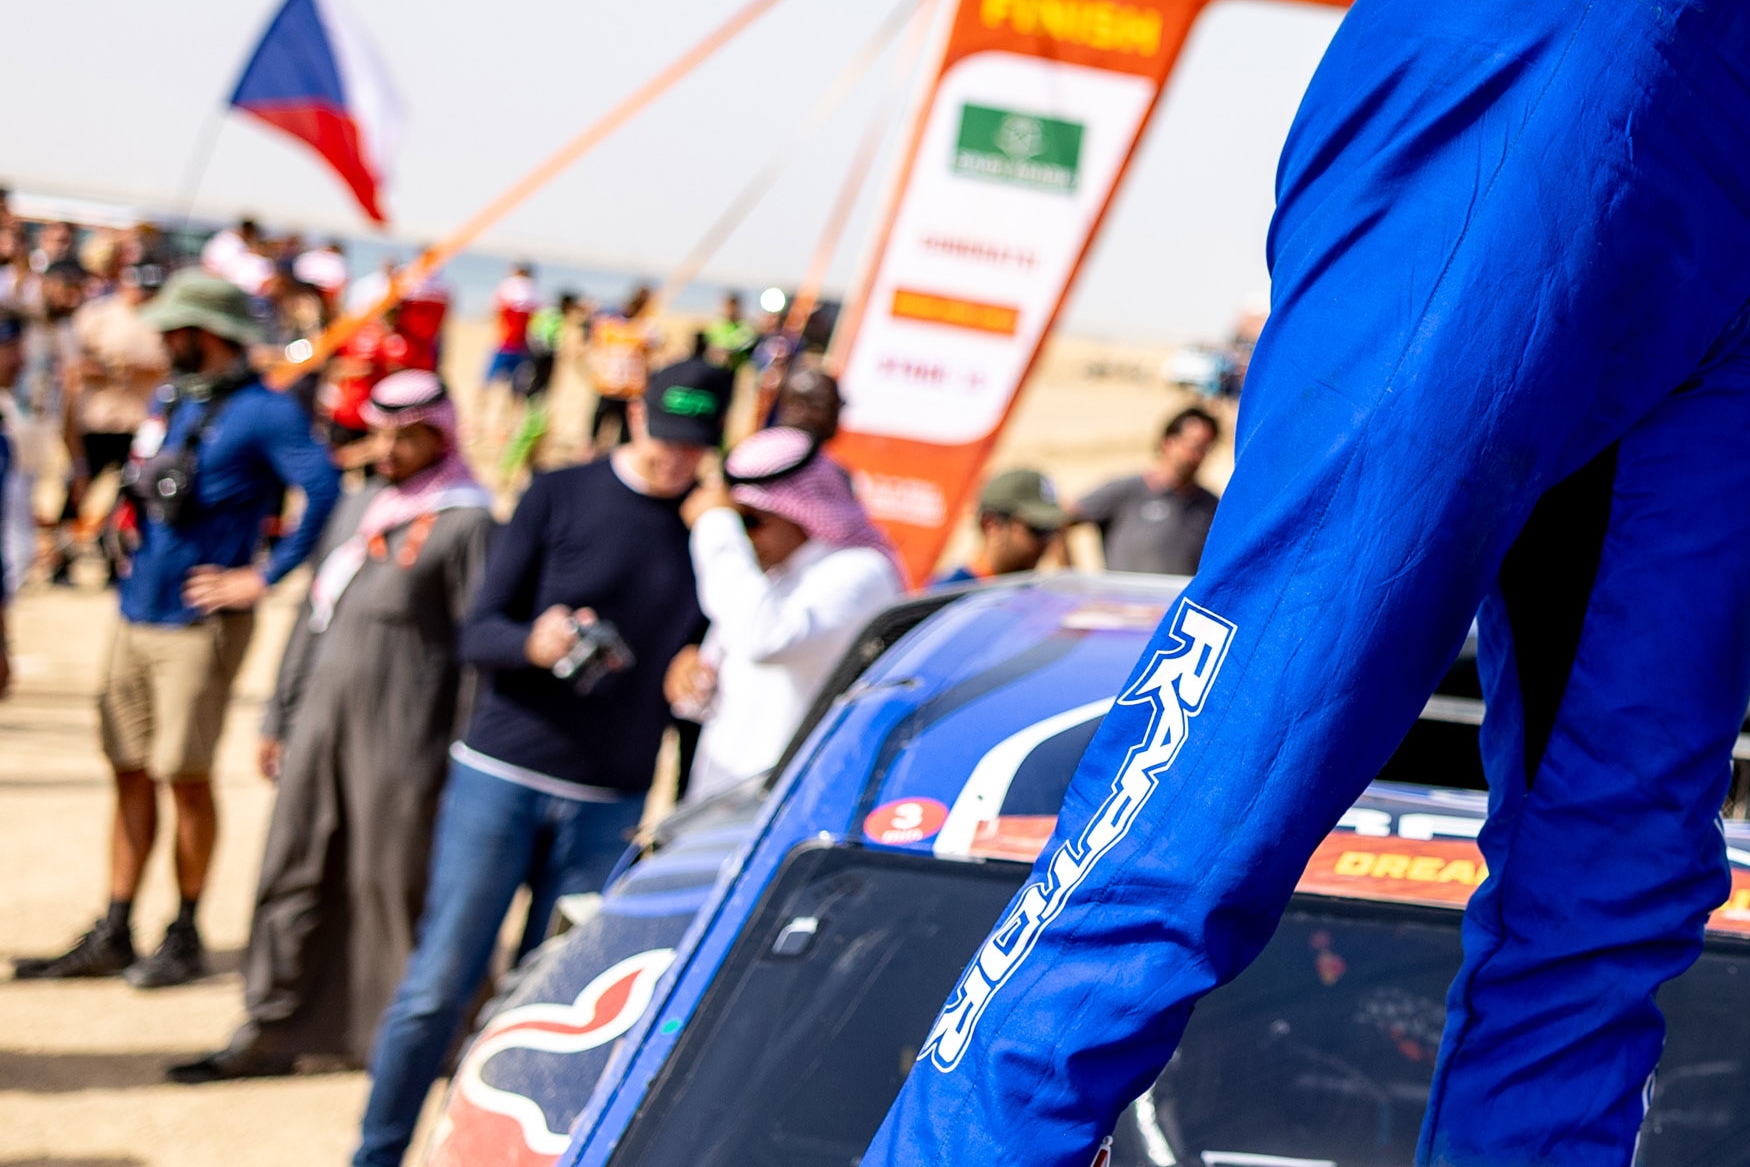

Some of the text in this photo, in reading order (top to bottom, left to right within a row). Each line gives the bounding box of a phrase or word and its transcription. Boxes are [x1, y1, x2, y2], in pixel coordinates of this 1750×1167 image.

[890, 802, 924, 830] 3
[912, 597, 1238, 1073] RAPTOR
[1334, 850, 1489, 886] DREA
